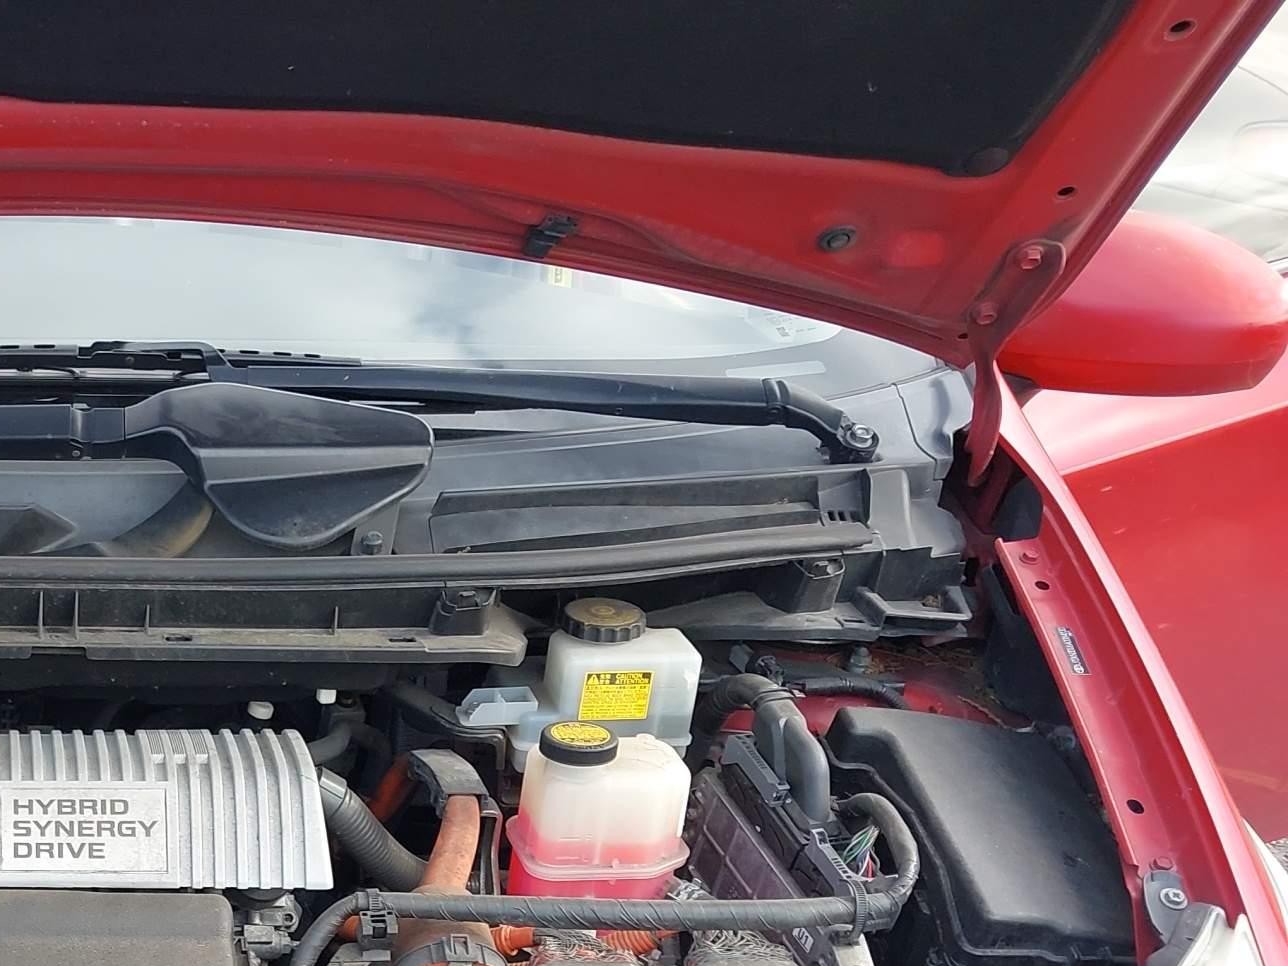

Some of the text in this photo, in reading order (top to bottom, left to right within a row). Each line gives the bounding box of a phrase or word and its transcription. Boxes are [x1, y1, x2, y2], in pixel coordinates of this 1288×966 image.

[13, 799, 129, 815] HYBRID
[13, 820, 158, 837] SYNERGY
[13, 842, 106, 859] DRIVE
